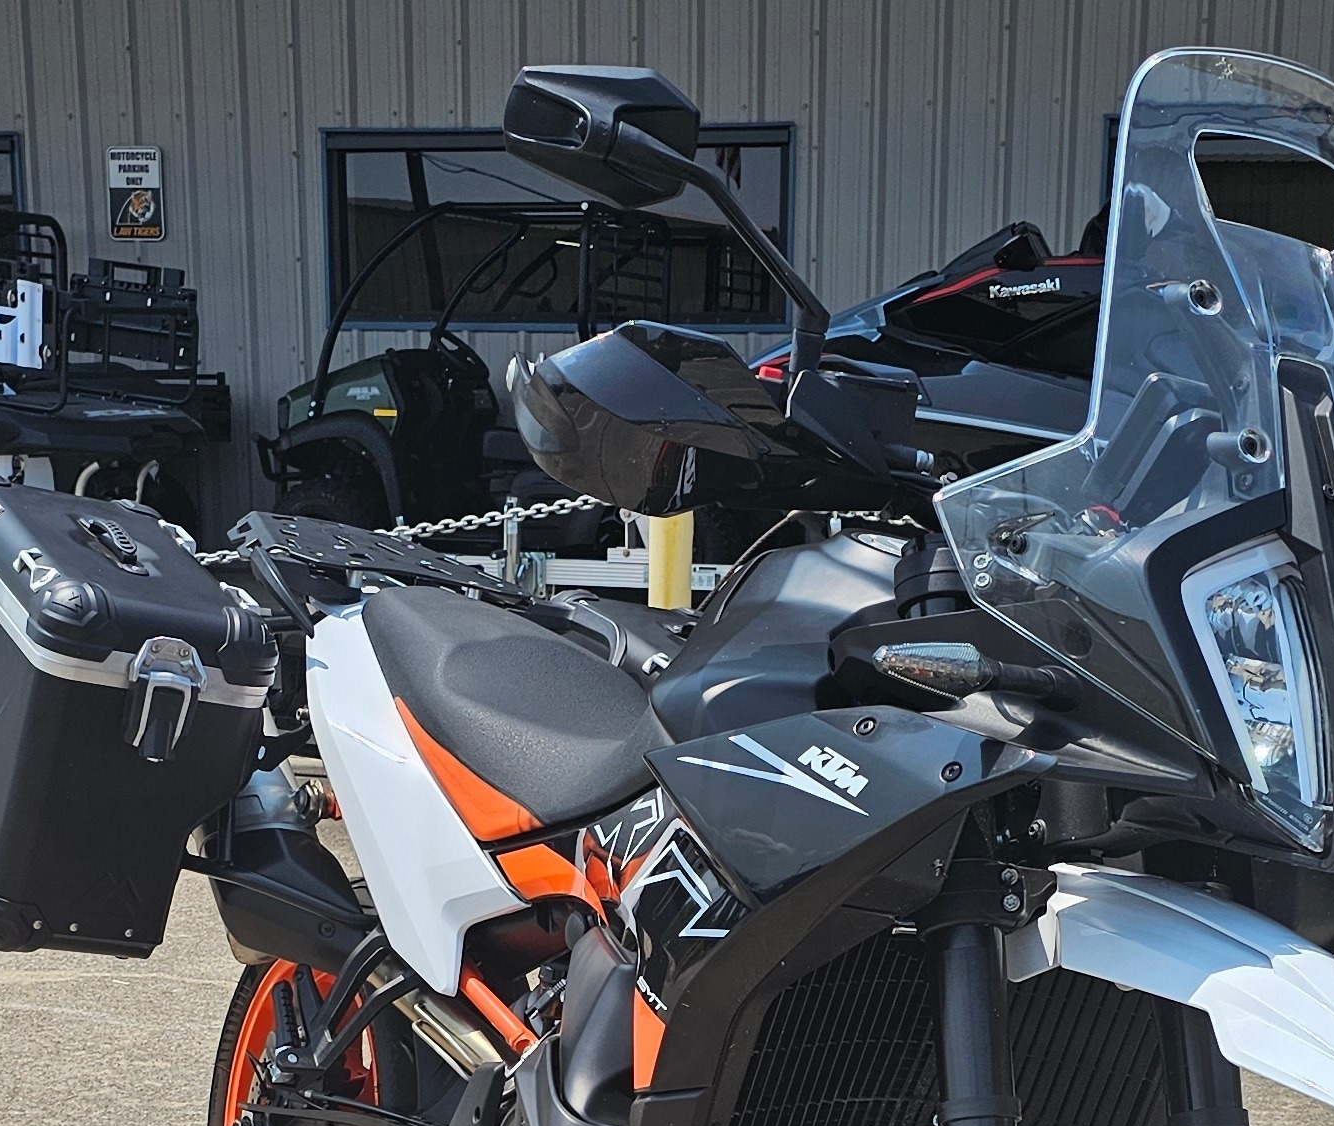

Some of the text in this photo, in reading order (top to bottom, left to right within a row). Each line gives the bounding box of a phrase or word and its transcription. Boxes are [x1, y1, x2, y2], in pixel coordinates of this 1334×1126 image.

[110, 152, 157, 161] MOTORCYCLE
[118, 164, 150, 173] PARKING
[125, 176, 143, 186] ONLY
[989, 277, 1061, 299] Kawasaki
[797, 745, 869, 798] KTM
[637, 975, 668, 1010] SMT
